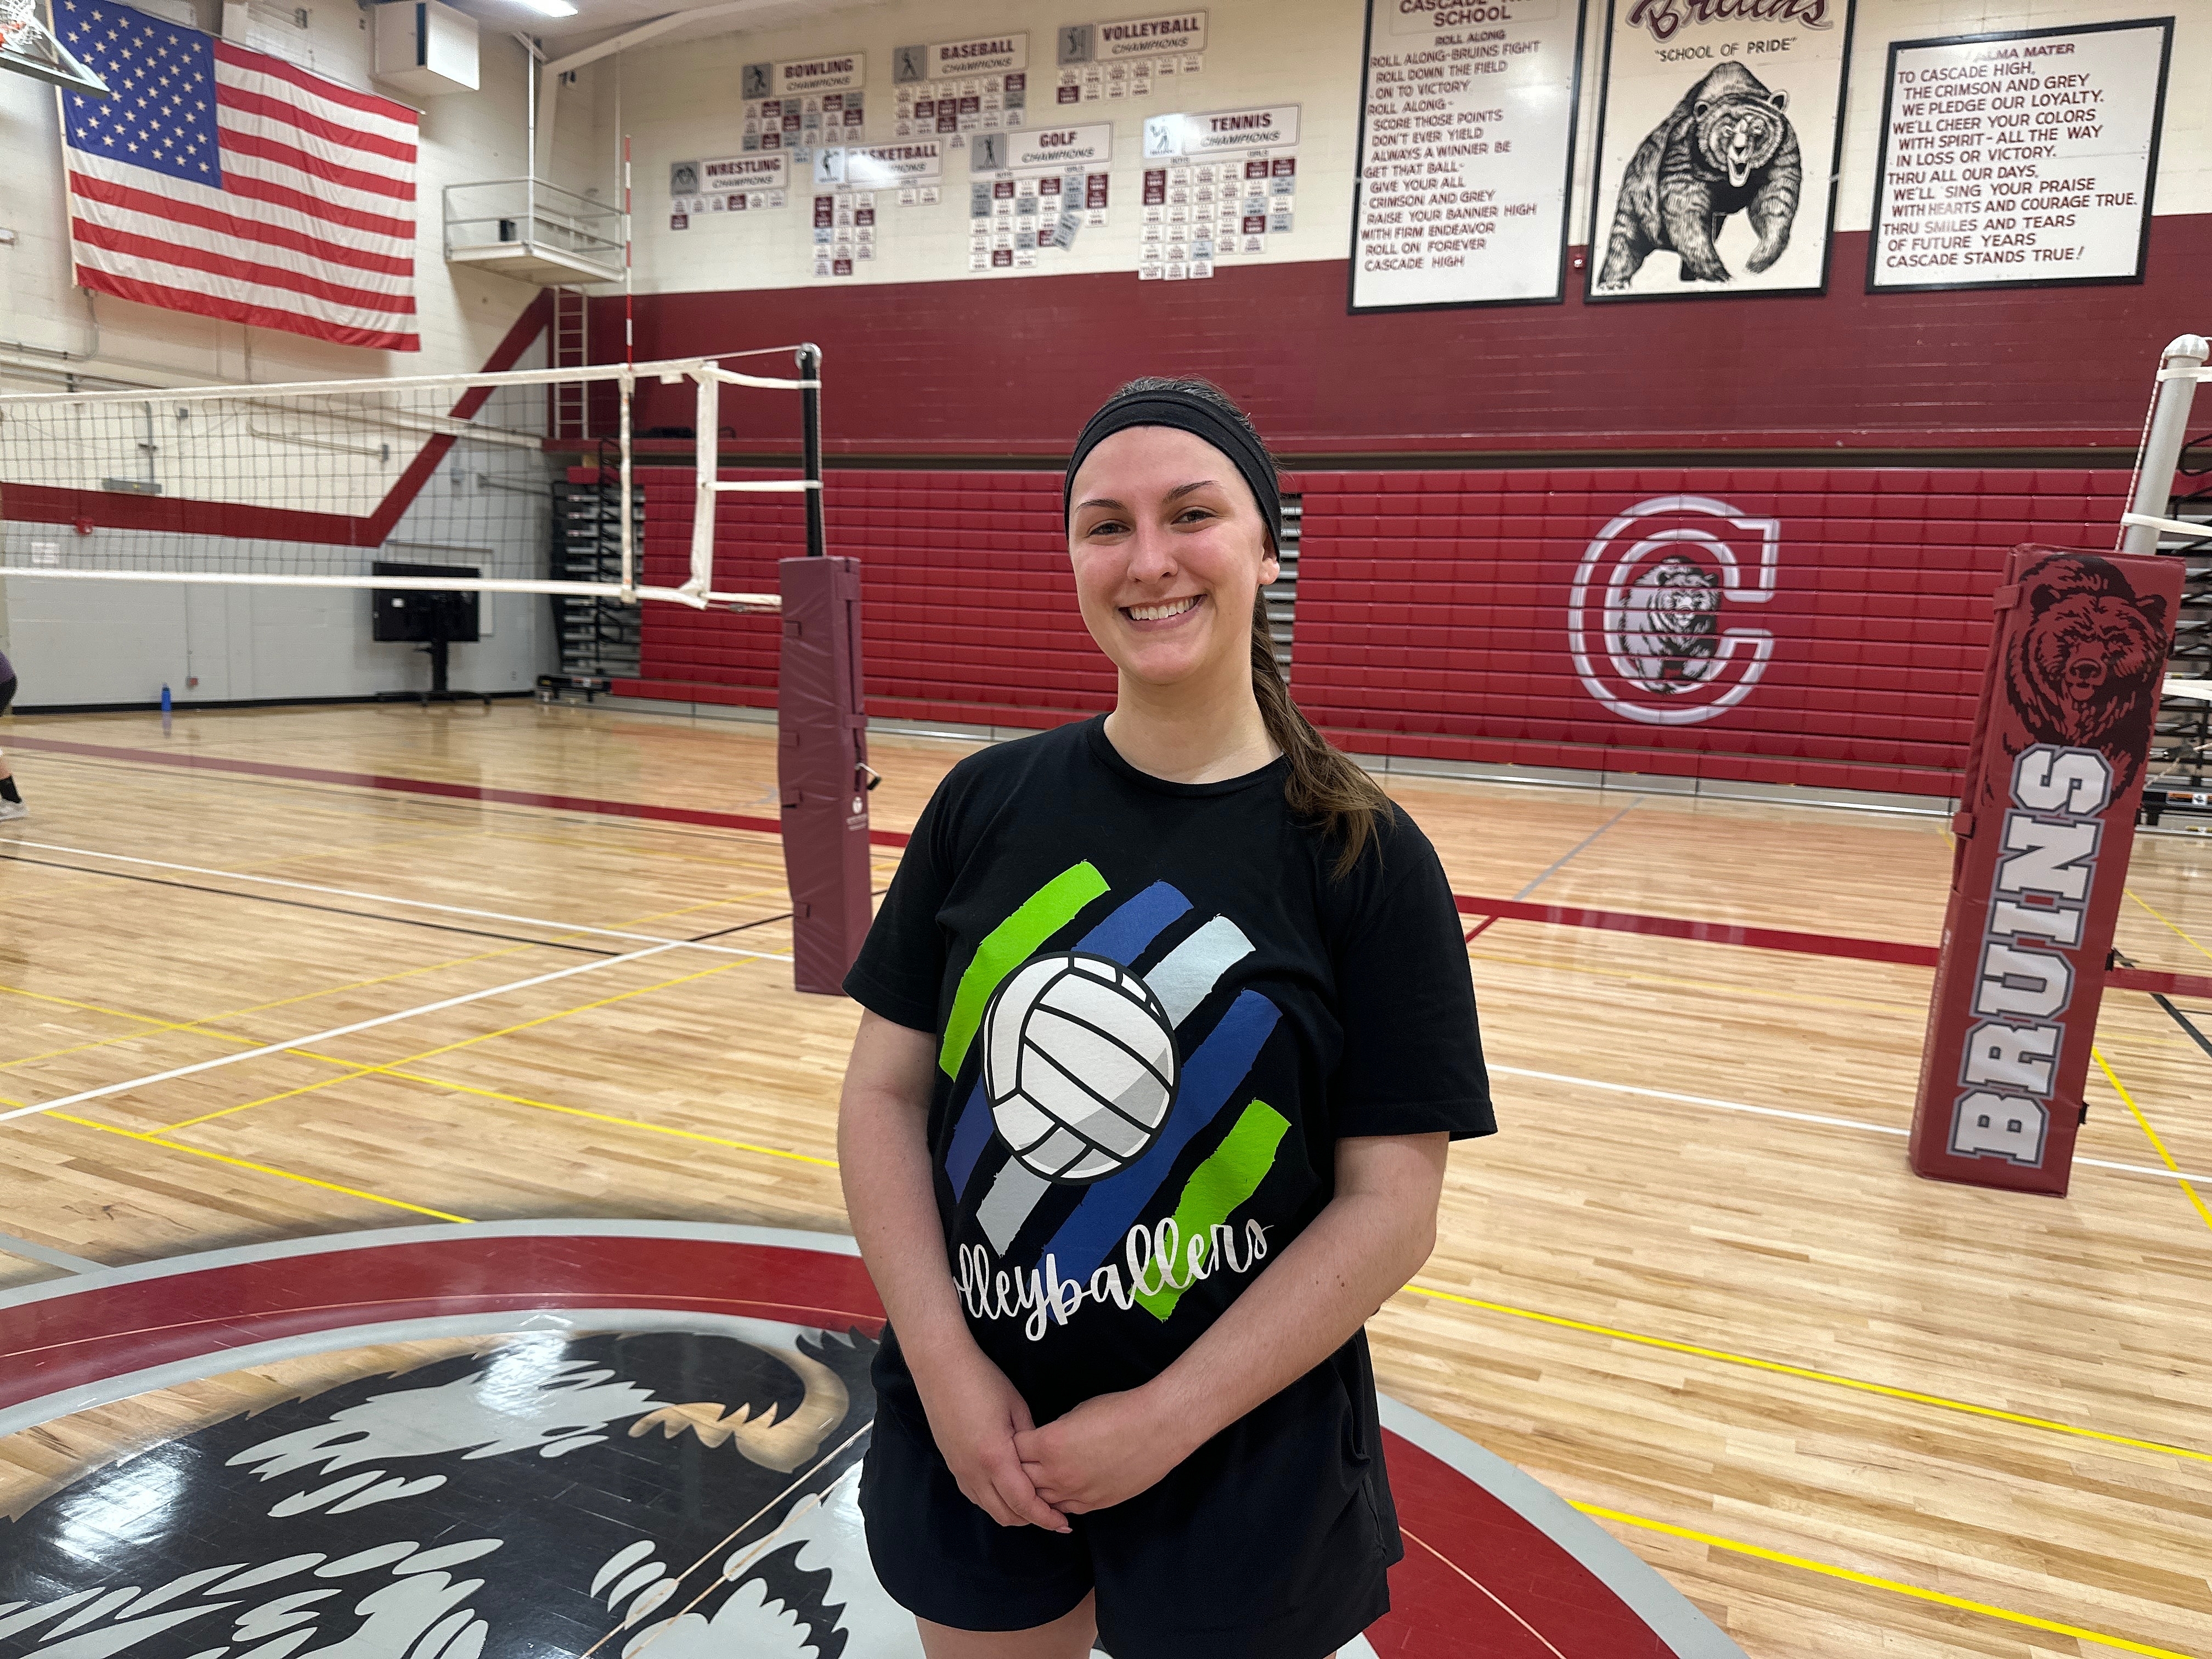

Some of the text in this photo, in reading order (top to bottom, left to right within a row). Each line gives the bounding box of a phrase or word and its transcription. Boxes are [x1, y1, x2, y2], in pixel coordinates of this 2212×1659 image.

[1433, 5, 1511, 27] SCHOOL
[1102, 16, 1200, 41] VOLLEYBALL
[1435, 29, 1506, 46] ROLL ALONG
[940, 39, 1015, 60] BASEBALL
[1111, 37, 1189, 54] CHAMPIONS
[1370, 54, 1401, 69] ROLL
[1502, 40, 1541, 55] FIGHT
[1720, 43, 1739, 57] OF
[2024, 43, 2075, 57] MATER
[784, 58, 854, 79] BOWLING
[1376, 60, 1509, 83] ROLL DOWN THE FIELD
[1898, 70, 1915, 84] TO
[1921, 64, 1988, 82] CASCADE
[1375, 88, 1392, 99] ON
[1398, 85, 1413, 98] TO
[1904, 72, 2091, 100] THE CRIMSON AND GREY
[1367, 103, 1397, 116] ROLL
[1902, 103, 1925, 117] WE
[1928, 98, 1987, 115] PLEDGE
[1991, 95, 2024, 110] OUR
[1210, 113, 1272, 132] TENNIS
[1373, 109, 1503, 131] SCORE THOSE POINTS
[1892, 109, 2096, 136] WE'LL CHEER YOUR COLORS
[1039, 131, 1078, 148] GOLF
[1372, 127, 1484, 147] DON'T EVER YIELD
[1898, 136, 1935, 150] WITH
[2029, 127, 2059, 142] THE
[2067, 125, 2104, 139] WAY
[1371, 140, 1512, 162] ALWAYS A WINNER BE
[1896, 145, 2057, 168] IN LOSS OR VICTORY.
[706, 157, 781, 176] WRESTLING
[1363, 166, 1387, 179] GET
[1392, 163, 1423, 176] THAT
[1887, 172, 1926, 185] THRU
[1928, 169, 1956, 183] ALL
[1961, 167, 1993, 181] OUR
[1370, 176, 1466, 194] GIVE YOUR ALL
[1894, 178, 2096, 201] WE'LL SING YOUR PRAISE
[1369, 189, 1496, 209] CRIMSON AND GREY
[1891, 202, 1926, 218] WITH
[1928, 199, 1981, 216] HEARTS
[1984, 199, 2016, 213] AND
[2021, 194, 2090, 211] COURAGE
[1367, 202, 1537, 225] RAISE YOUR BANNER HIGH
[1361, 221, 1496, 240] WITH FIRM ENDEAVOR
[1882, 214, 2076, 236] THRU SMILES AND TEARS
[1366, 238, 1486, 256] ROLL ON FOREVER
[1888, 233, 2037, 252] OF FUTURE YEARS
[1364, 255, 1465, 272] CASCADE HIGH
[1887, 246, 2084, 268] CASCADE STANDS TRUE!
[1946, 741, 2114, 1171] BRUINS
